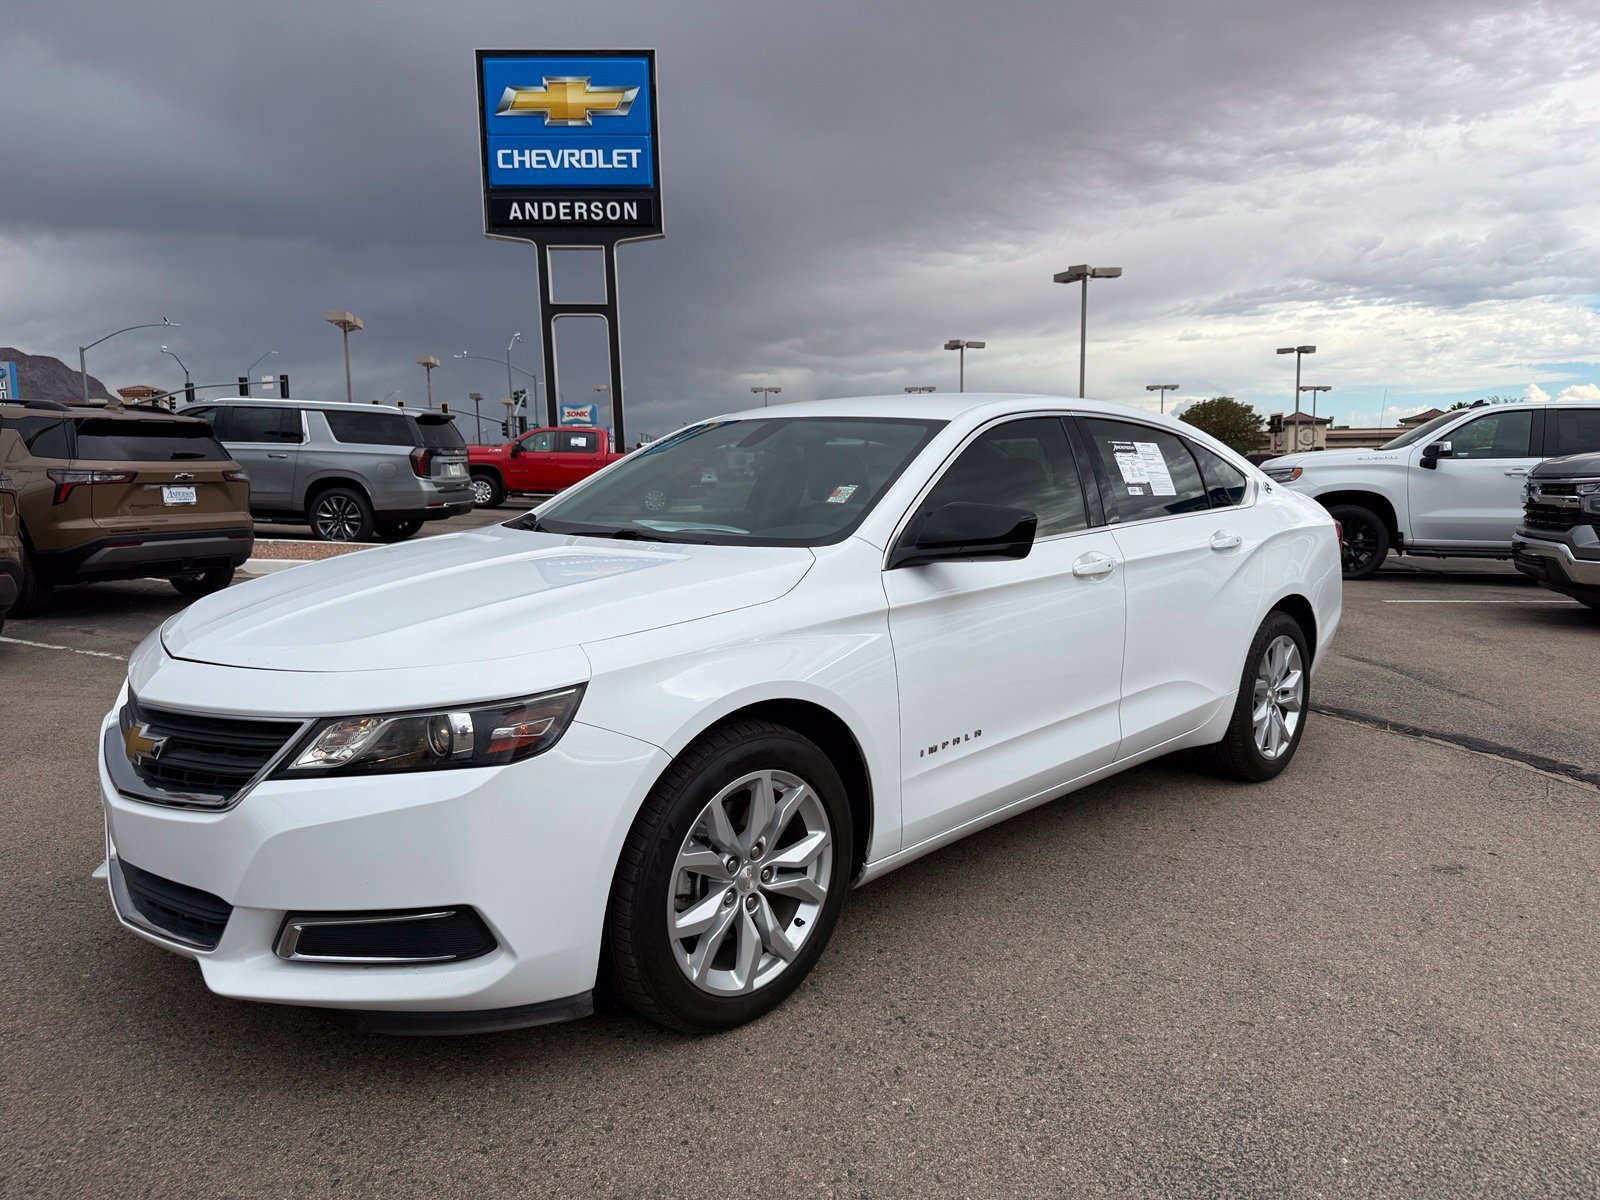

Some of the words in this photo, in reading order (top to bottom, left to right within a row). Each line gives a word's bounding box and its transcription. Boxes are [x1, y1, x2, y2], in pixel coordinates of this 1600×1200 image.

[497, 149, 641, 169] CHEVROLET
[509, 202, 638, 220] ANDERSON
[920, 729, 982, 758] IMPALA
